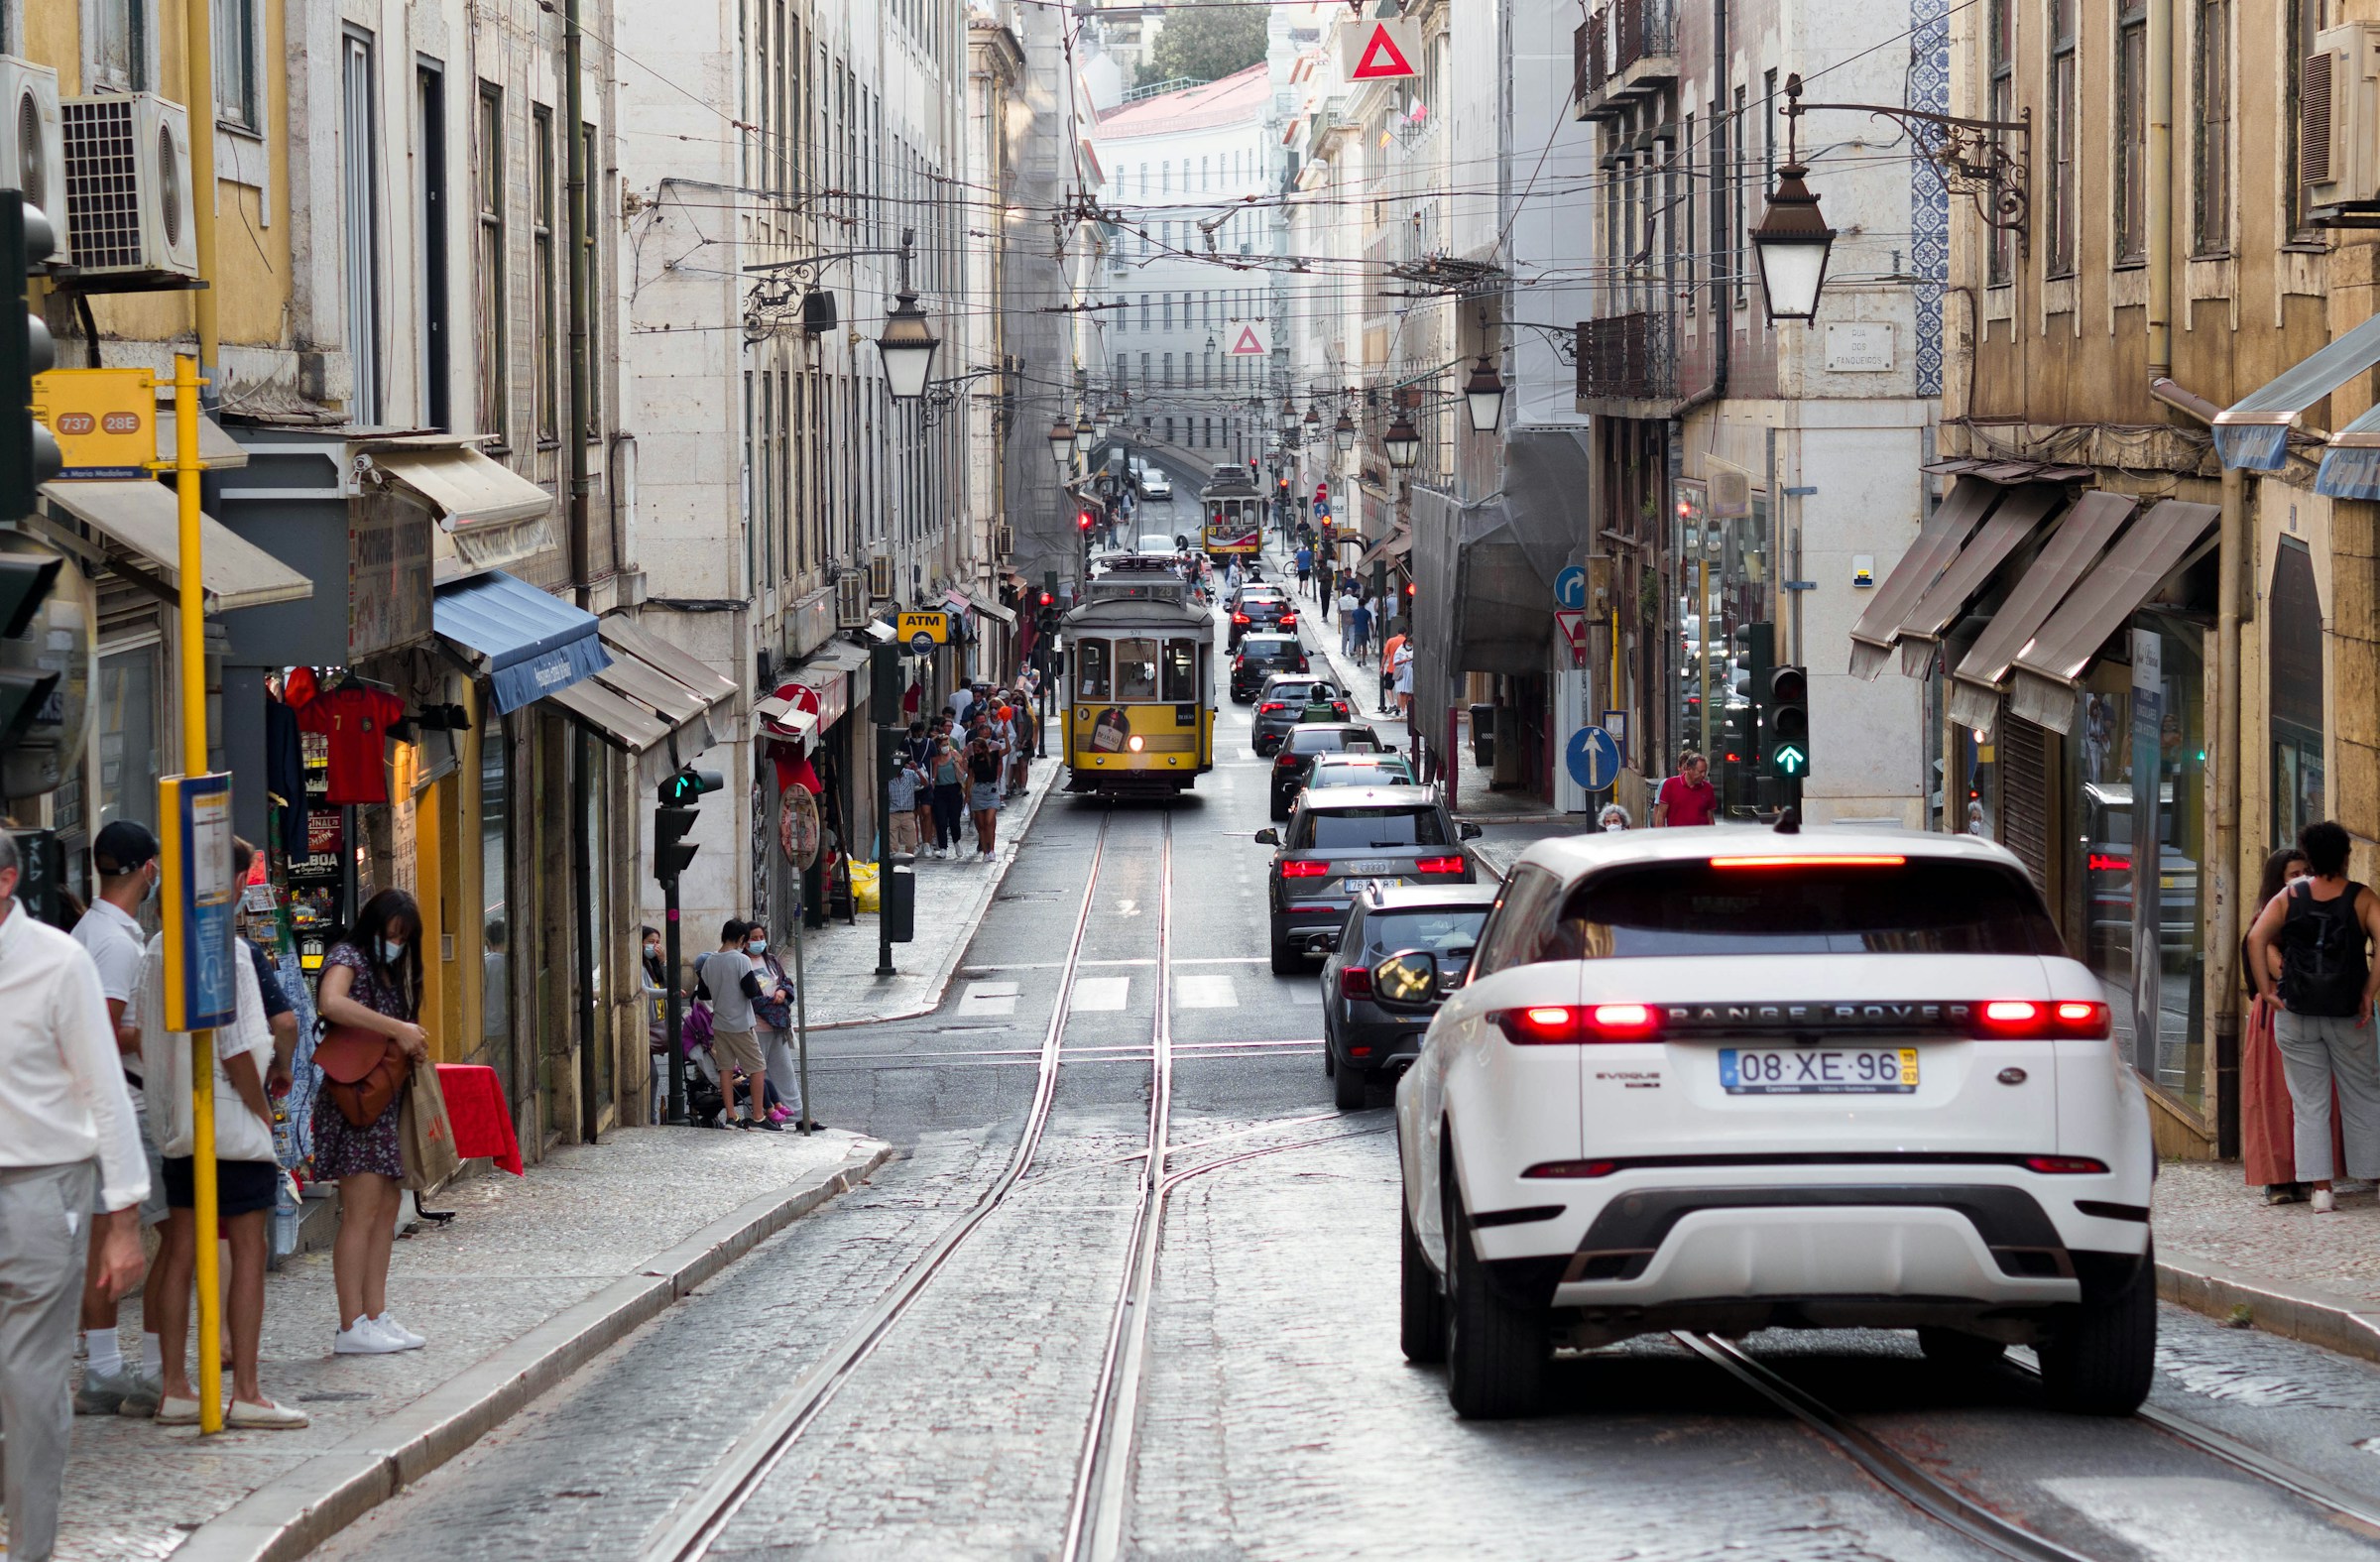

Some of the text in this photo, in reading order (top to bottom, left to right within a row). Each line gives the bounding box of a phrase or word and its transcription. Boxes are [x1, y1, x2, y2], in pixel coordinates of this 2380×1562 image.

[1851, 342, 1866, 351] DOS
[1837, 356, 1882, 365] FANQUEIROS
[61, 417, 136, 430] 737 28E
[1158, 586, 1172, 597] 28
[905, 616, 940, 626] ATM
[333, 715, 341, 731] 7
[288, 853, 338, 870] LBOA
[1668, 1006, 1969, 1020] RANGE ROVER
